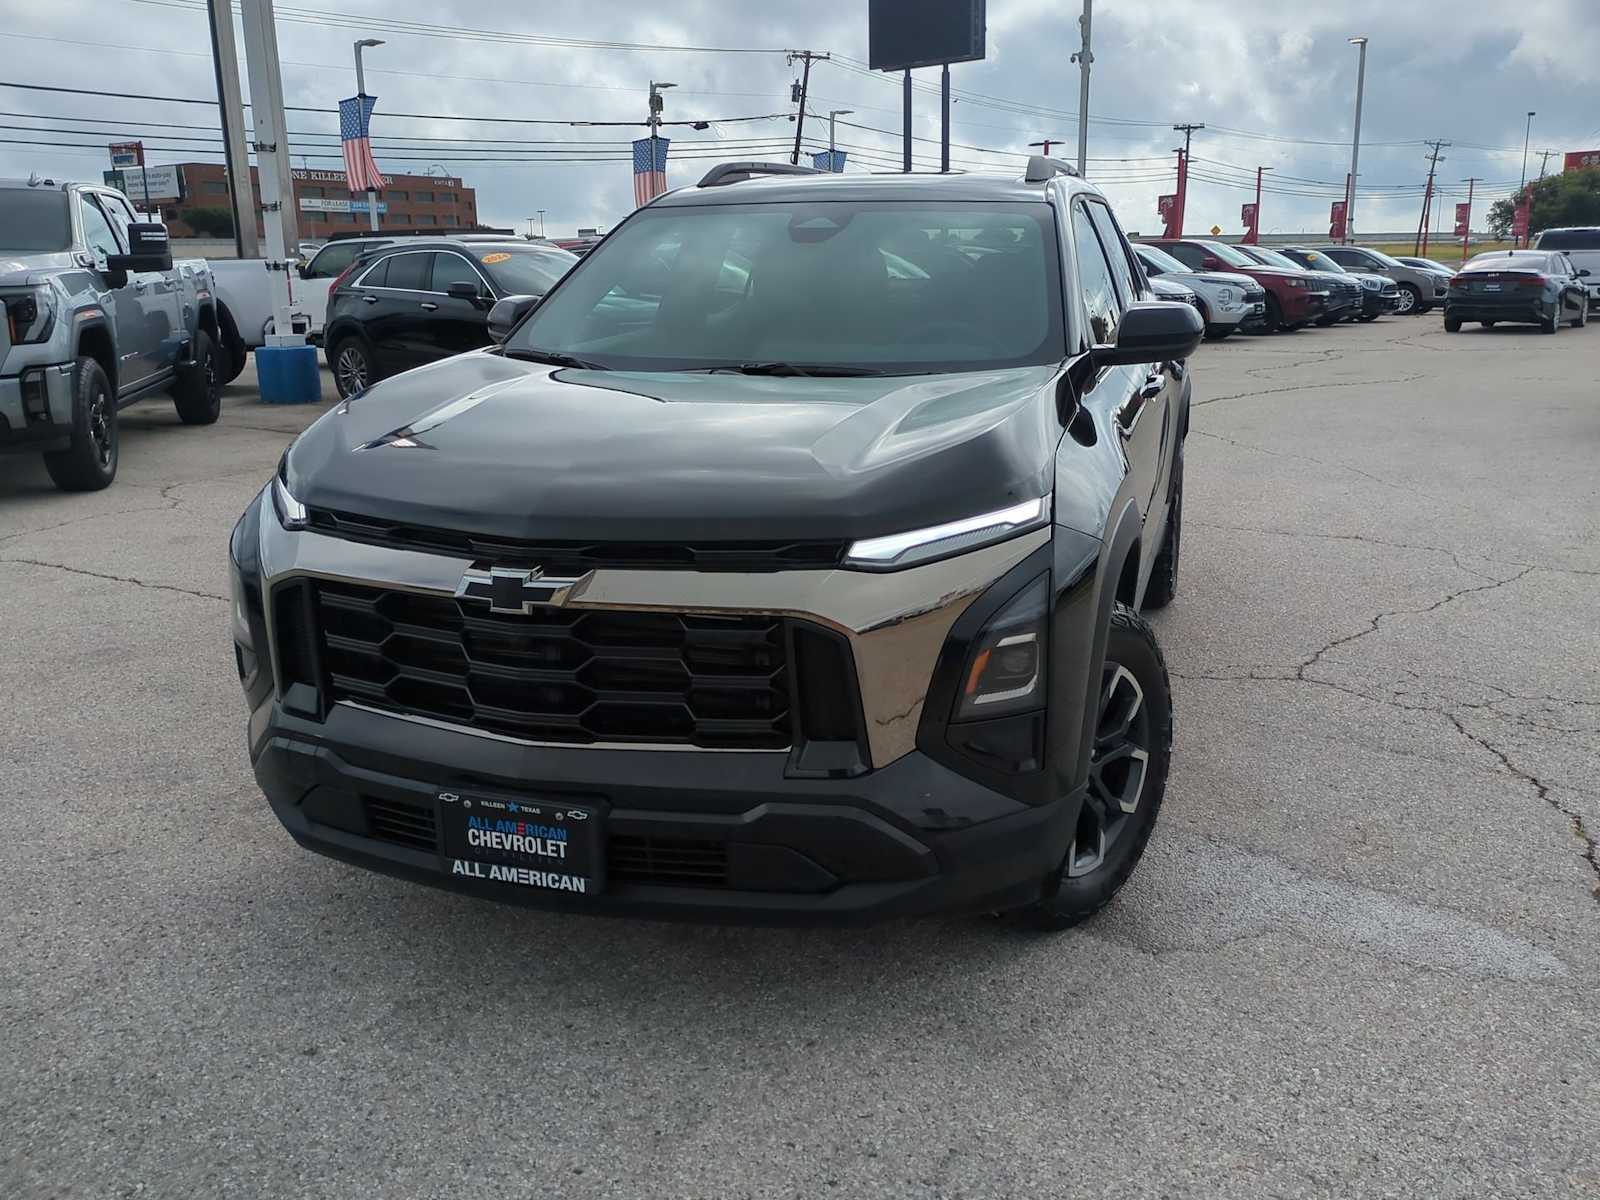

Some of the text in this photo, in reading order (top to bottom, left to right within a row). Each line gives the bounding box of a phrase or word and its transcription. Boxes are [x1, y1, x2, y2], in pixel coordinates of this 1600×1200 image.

[310, 171, 347, 182] KILLEE
[480, 801, 541, 814] KILLEEN TEXAS
[468, 815, 567, 841] ALL AMERICAN
[468, 828, 567, 858] CHEVROLET
[452, 859, 586, 893] ALL AMERICAN
